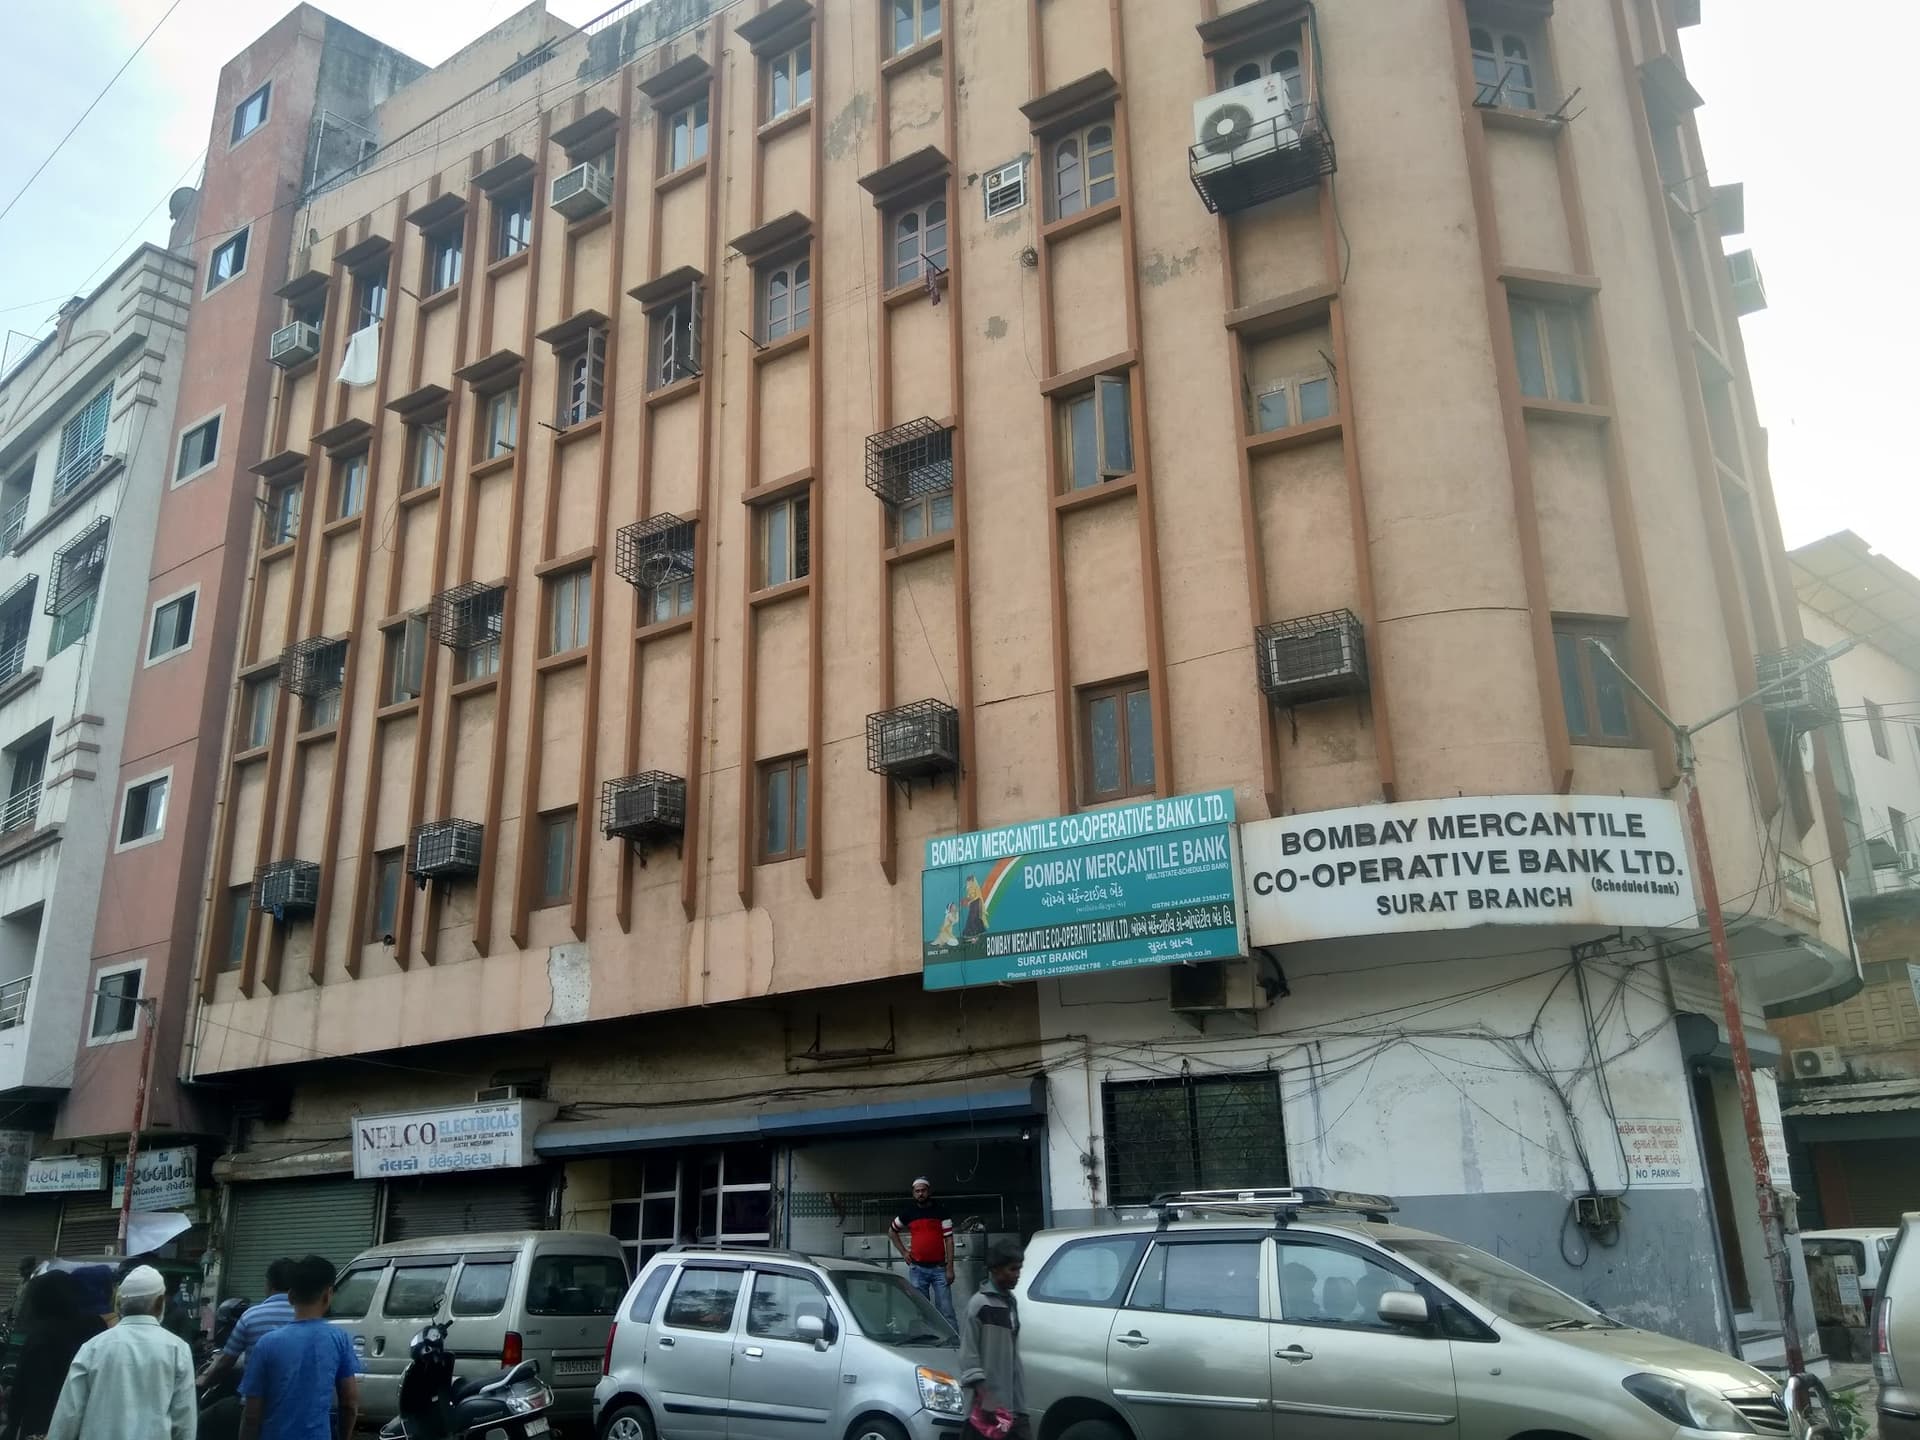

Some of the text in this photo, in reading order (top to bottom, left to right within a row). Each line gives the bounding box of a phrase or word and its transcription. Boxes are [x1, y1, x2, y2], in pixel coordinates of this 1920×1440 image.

[931, 793, 1228, 866] BOMBAY MERCANTILE CO-OPERATIVE BANK LTD.
[1281, 812, 1647, 856] BOMBAY MERCANTILE
[1024, 834, 1228, 890] BOMBAY MERCANTILE BANK
[1253, 848, 1684, 897] CO-OPERATIVE BANK LTD.
[1377, 887, 1573, 917] SURAT BRANCH
[1591, 877, 1680, 897] (Scheduled Bank)
[986, 934, 1011, 956] BOMBAY
[1011, 928, 1050, 954] MERCANTILE
[1051, 921, 1097, 948] CO-OPERATIVE
[1097, 920, 1116, 942] BANK
[1147, 940, 1167, 954] સુરત
[1017, 949, 1088, 967] SURAT BRANCH
[1111, 957, 1133, 967] E-mail
[361, 1113, 520, 1151] NELCO ELECTRICALS
[1635, 1168, 1680, 1179] NO PARKING
